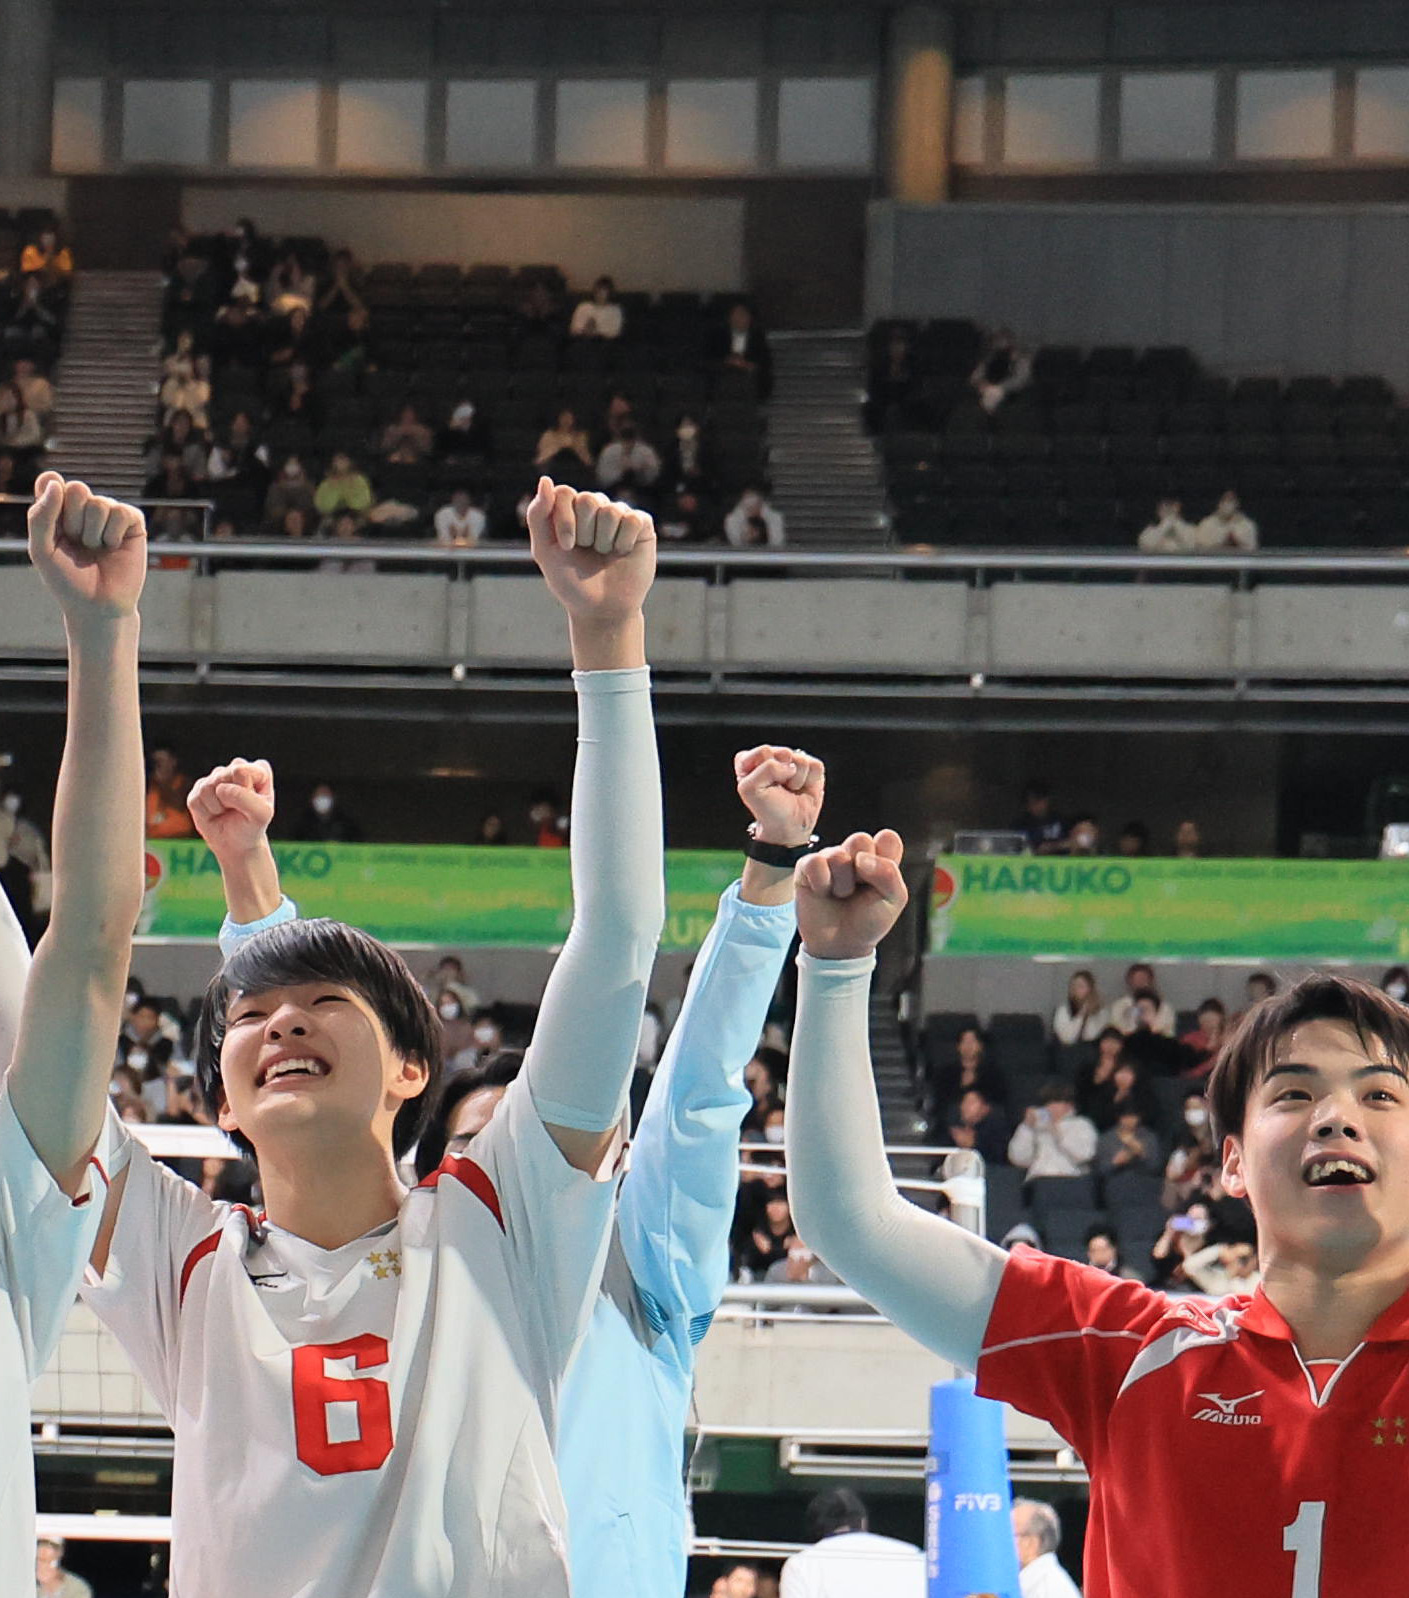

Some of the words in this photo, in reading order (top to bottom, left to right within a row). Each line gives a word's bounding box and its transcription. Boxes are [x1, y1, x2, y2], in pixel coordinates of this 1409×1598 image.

[170, 846, 332, 879] HAKO
[963, 864, 1132, 895] HARUKO
[291, 1333, 394, 1477] 6
[1192, 1408, 1262, 1426] MIZUNO
